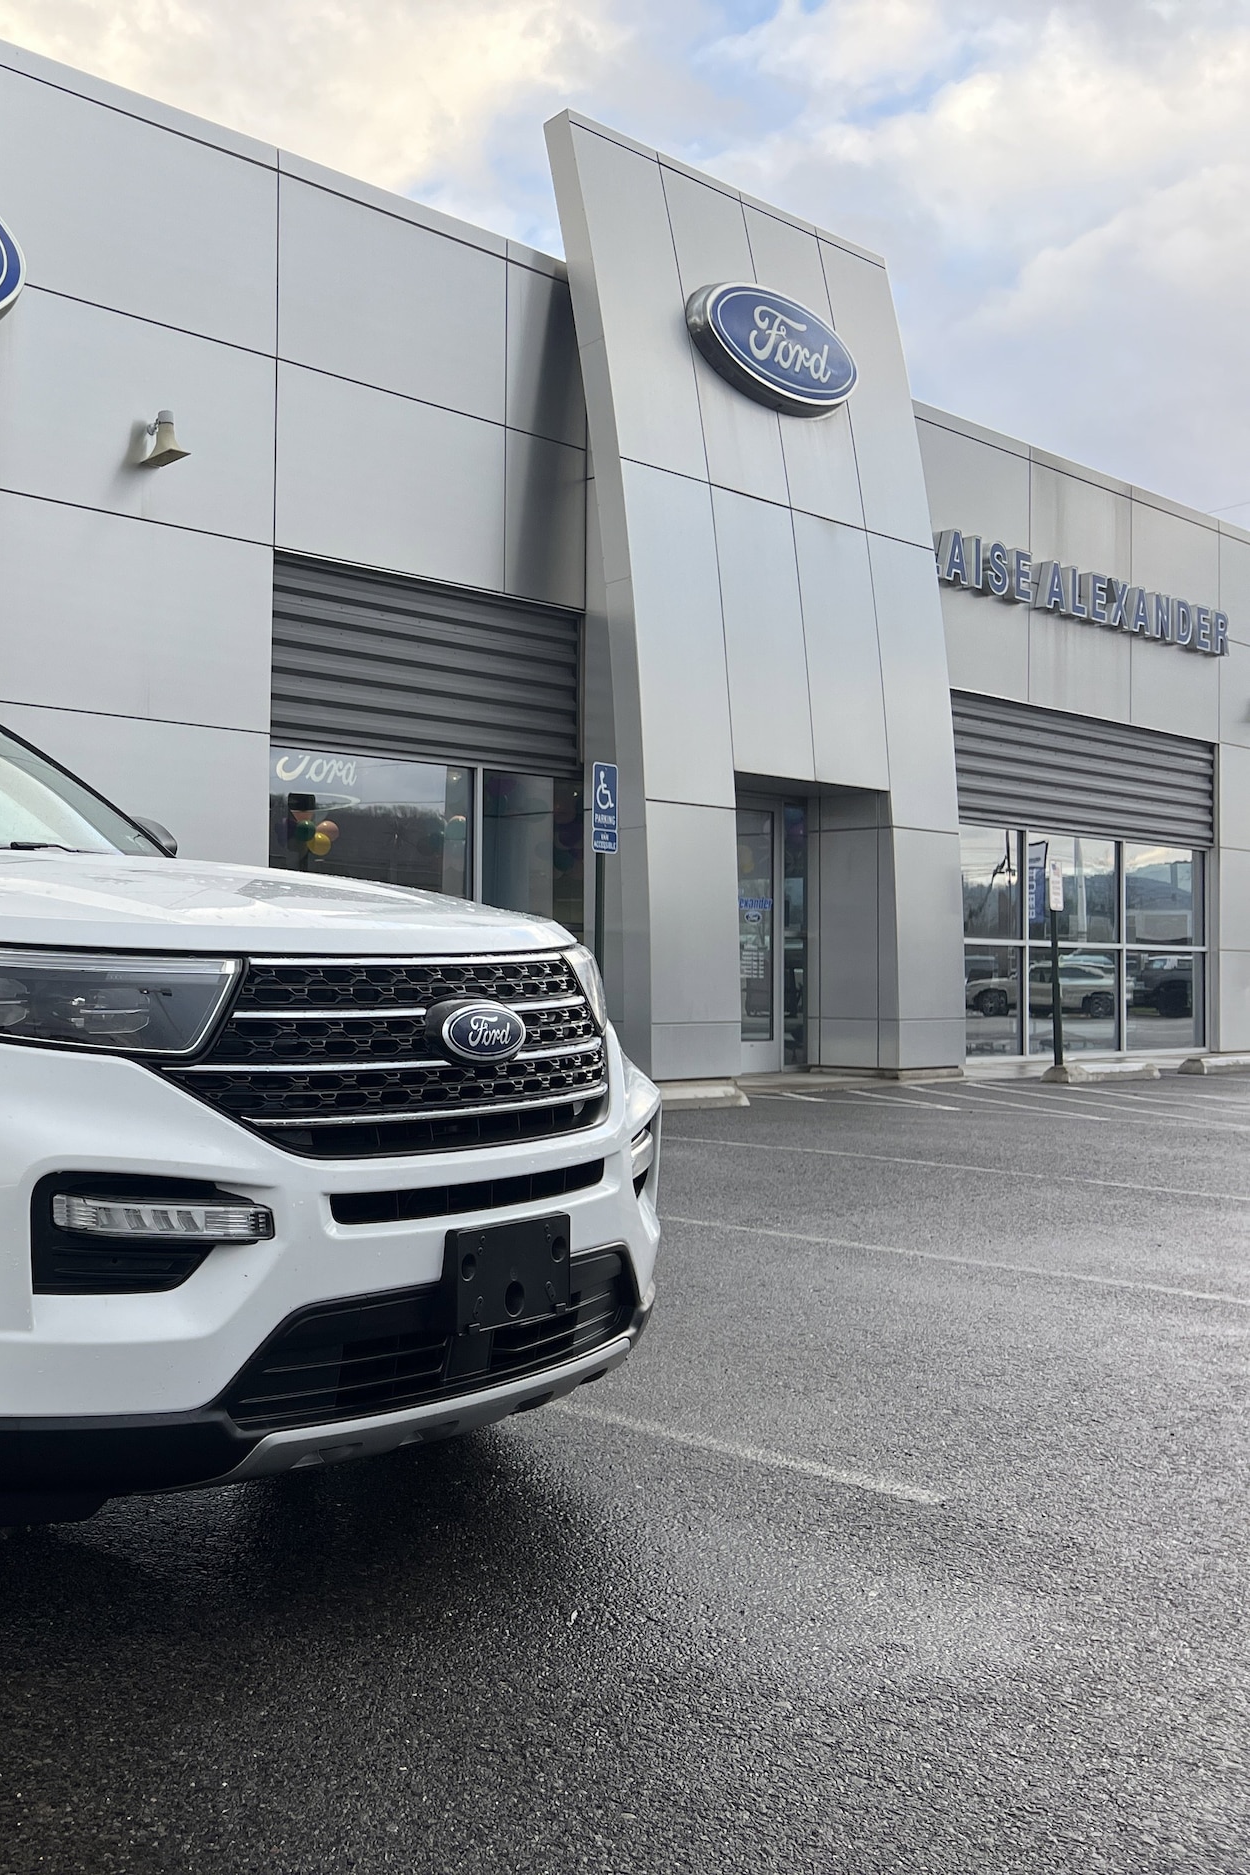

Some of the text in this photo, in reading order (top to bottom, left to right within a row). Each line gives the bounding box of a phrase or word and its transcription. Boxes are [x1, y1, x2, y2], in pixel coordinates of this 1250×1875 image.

[749, 305, 832, 384] Ford
[936, 530, 1230, 656] AISE ALEXANDER
[594, 813, 616, 826] PARKING
[468, 1015, 512, 1047] Ford
